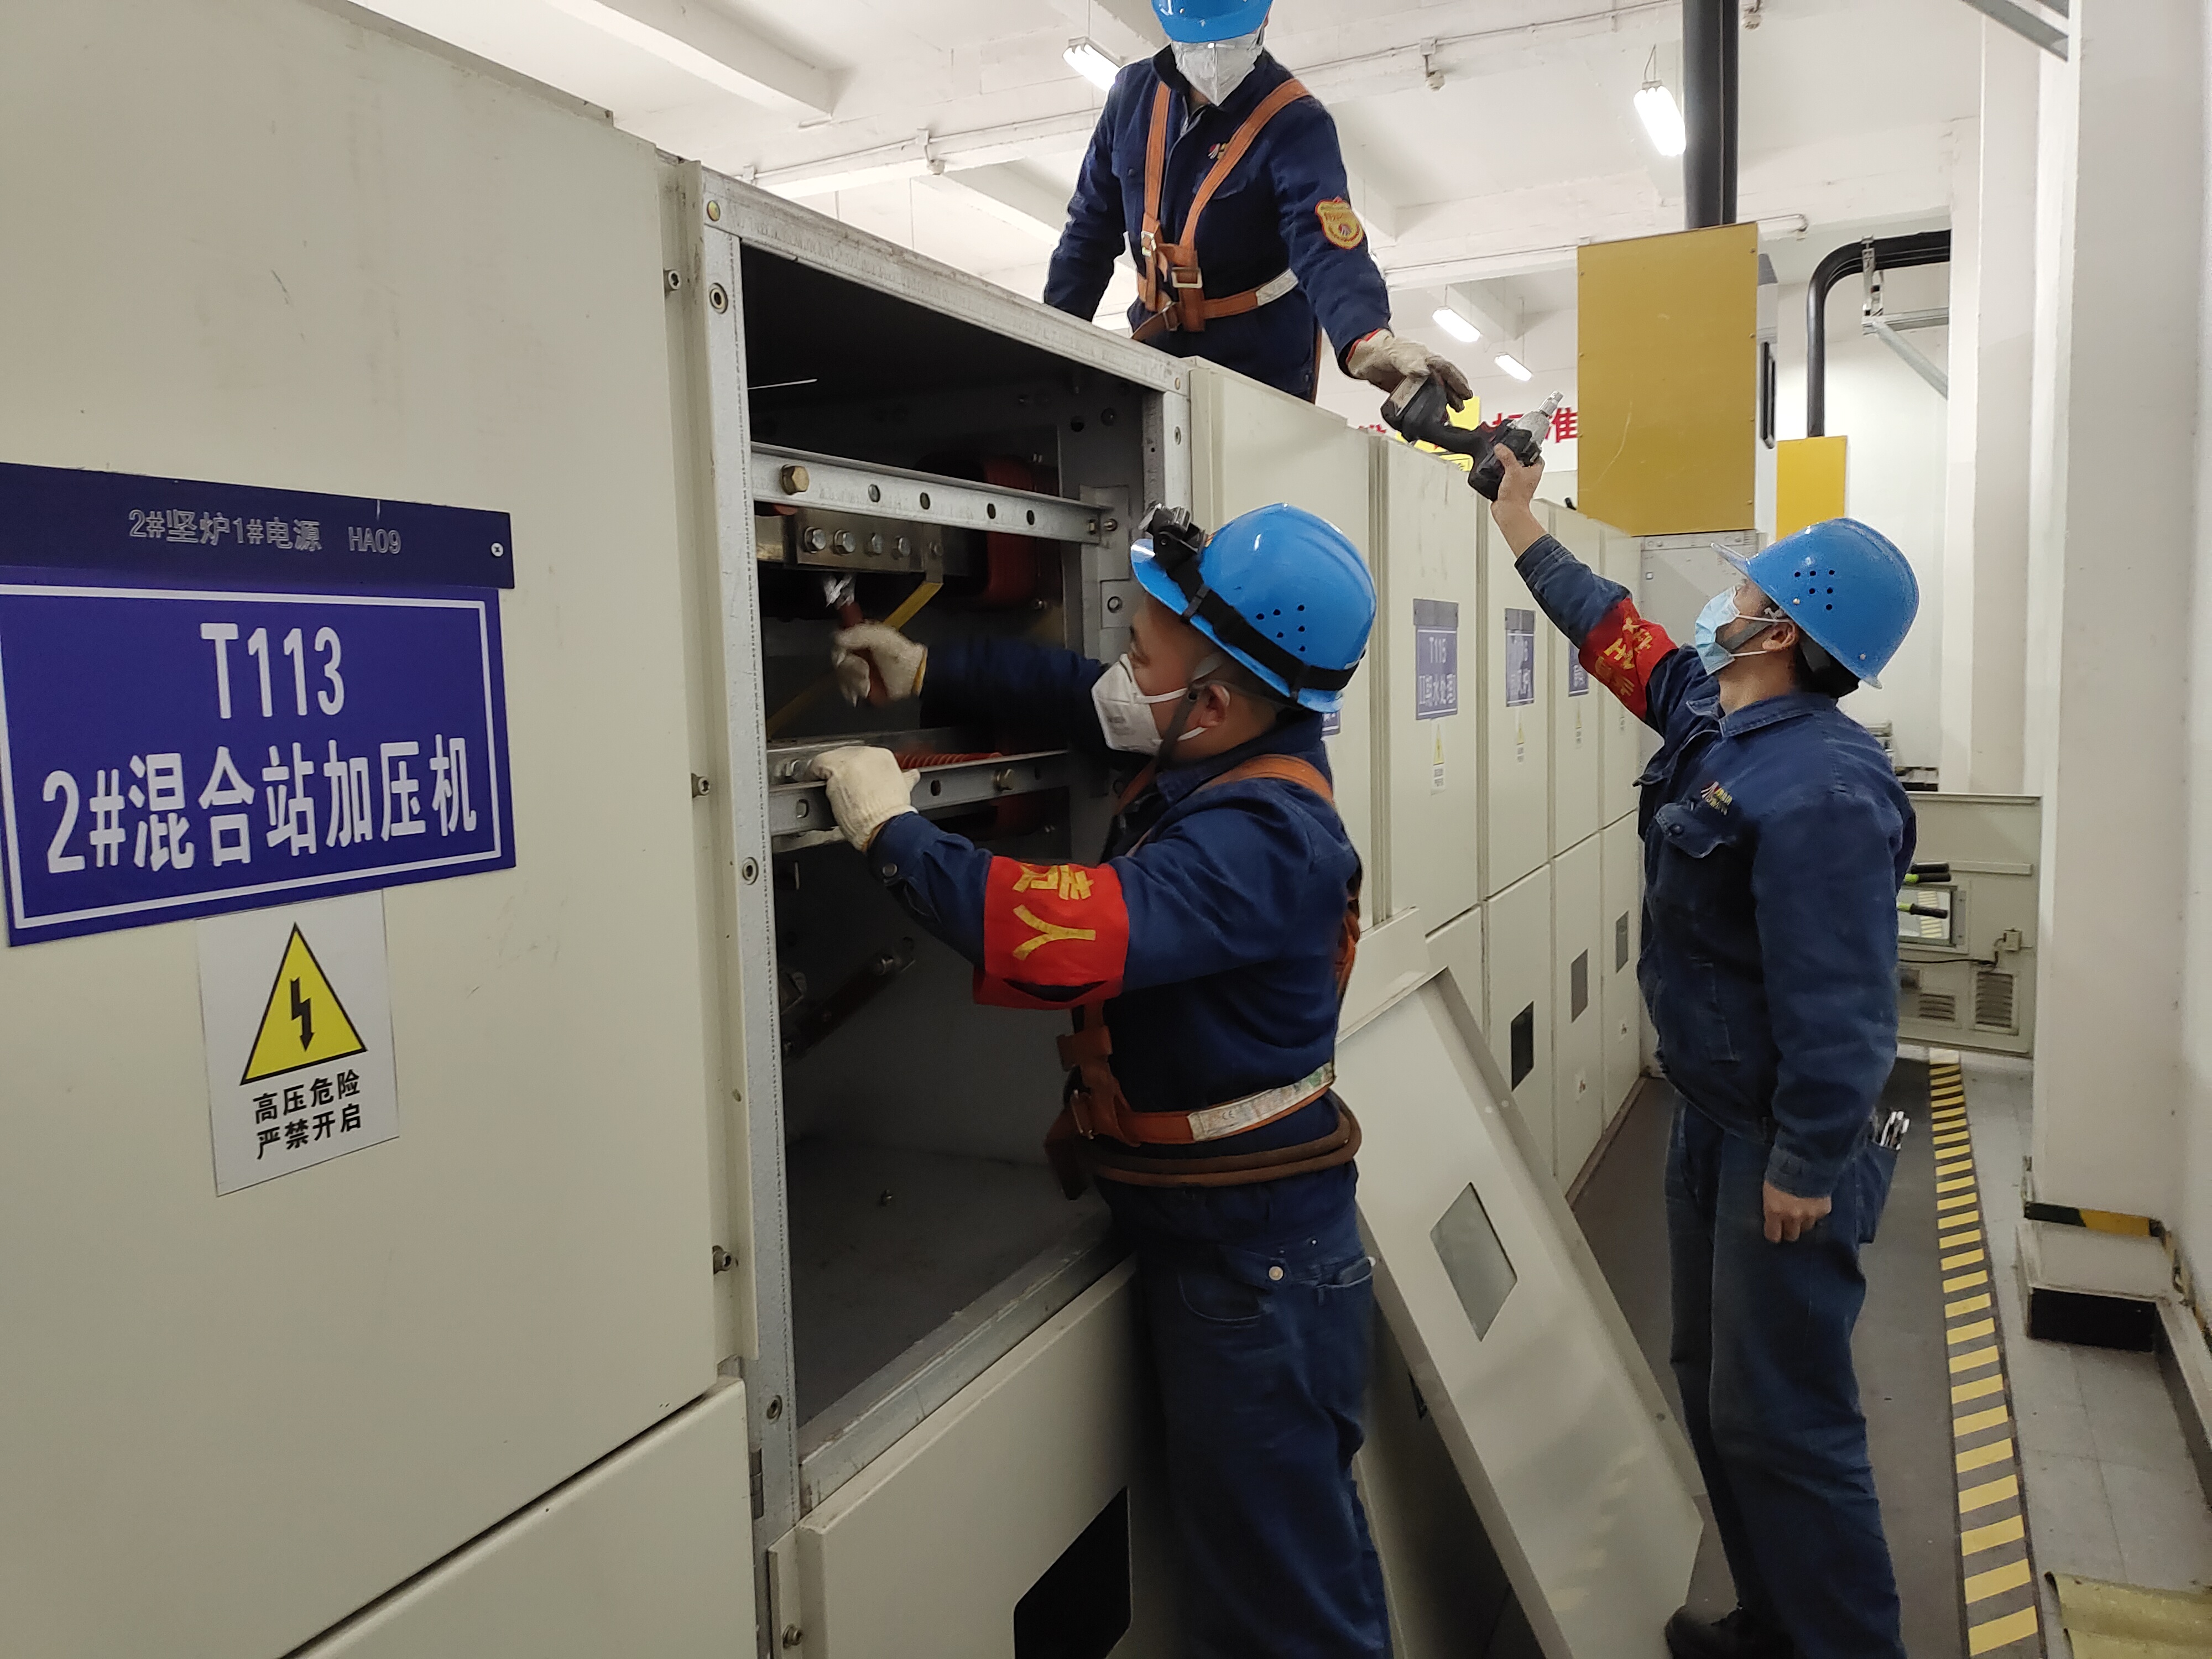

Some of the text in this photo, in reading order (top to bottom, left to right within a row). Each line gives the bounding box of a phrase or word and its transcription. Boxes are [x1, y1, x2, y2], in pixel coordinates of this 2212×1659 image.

[200, 623, 345, 719] T113
[43, 734, 477, 874] 2#混合站加压机
[253, 1069, 361, 1124] 高压危险
[257, 1103, 361, 1160] 严禁开启
